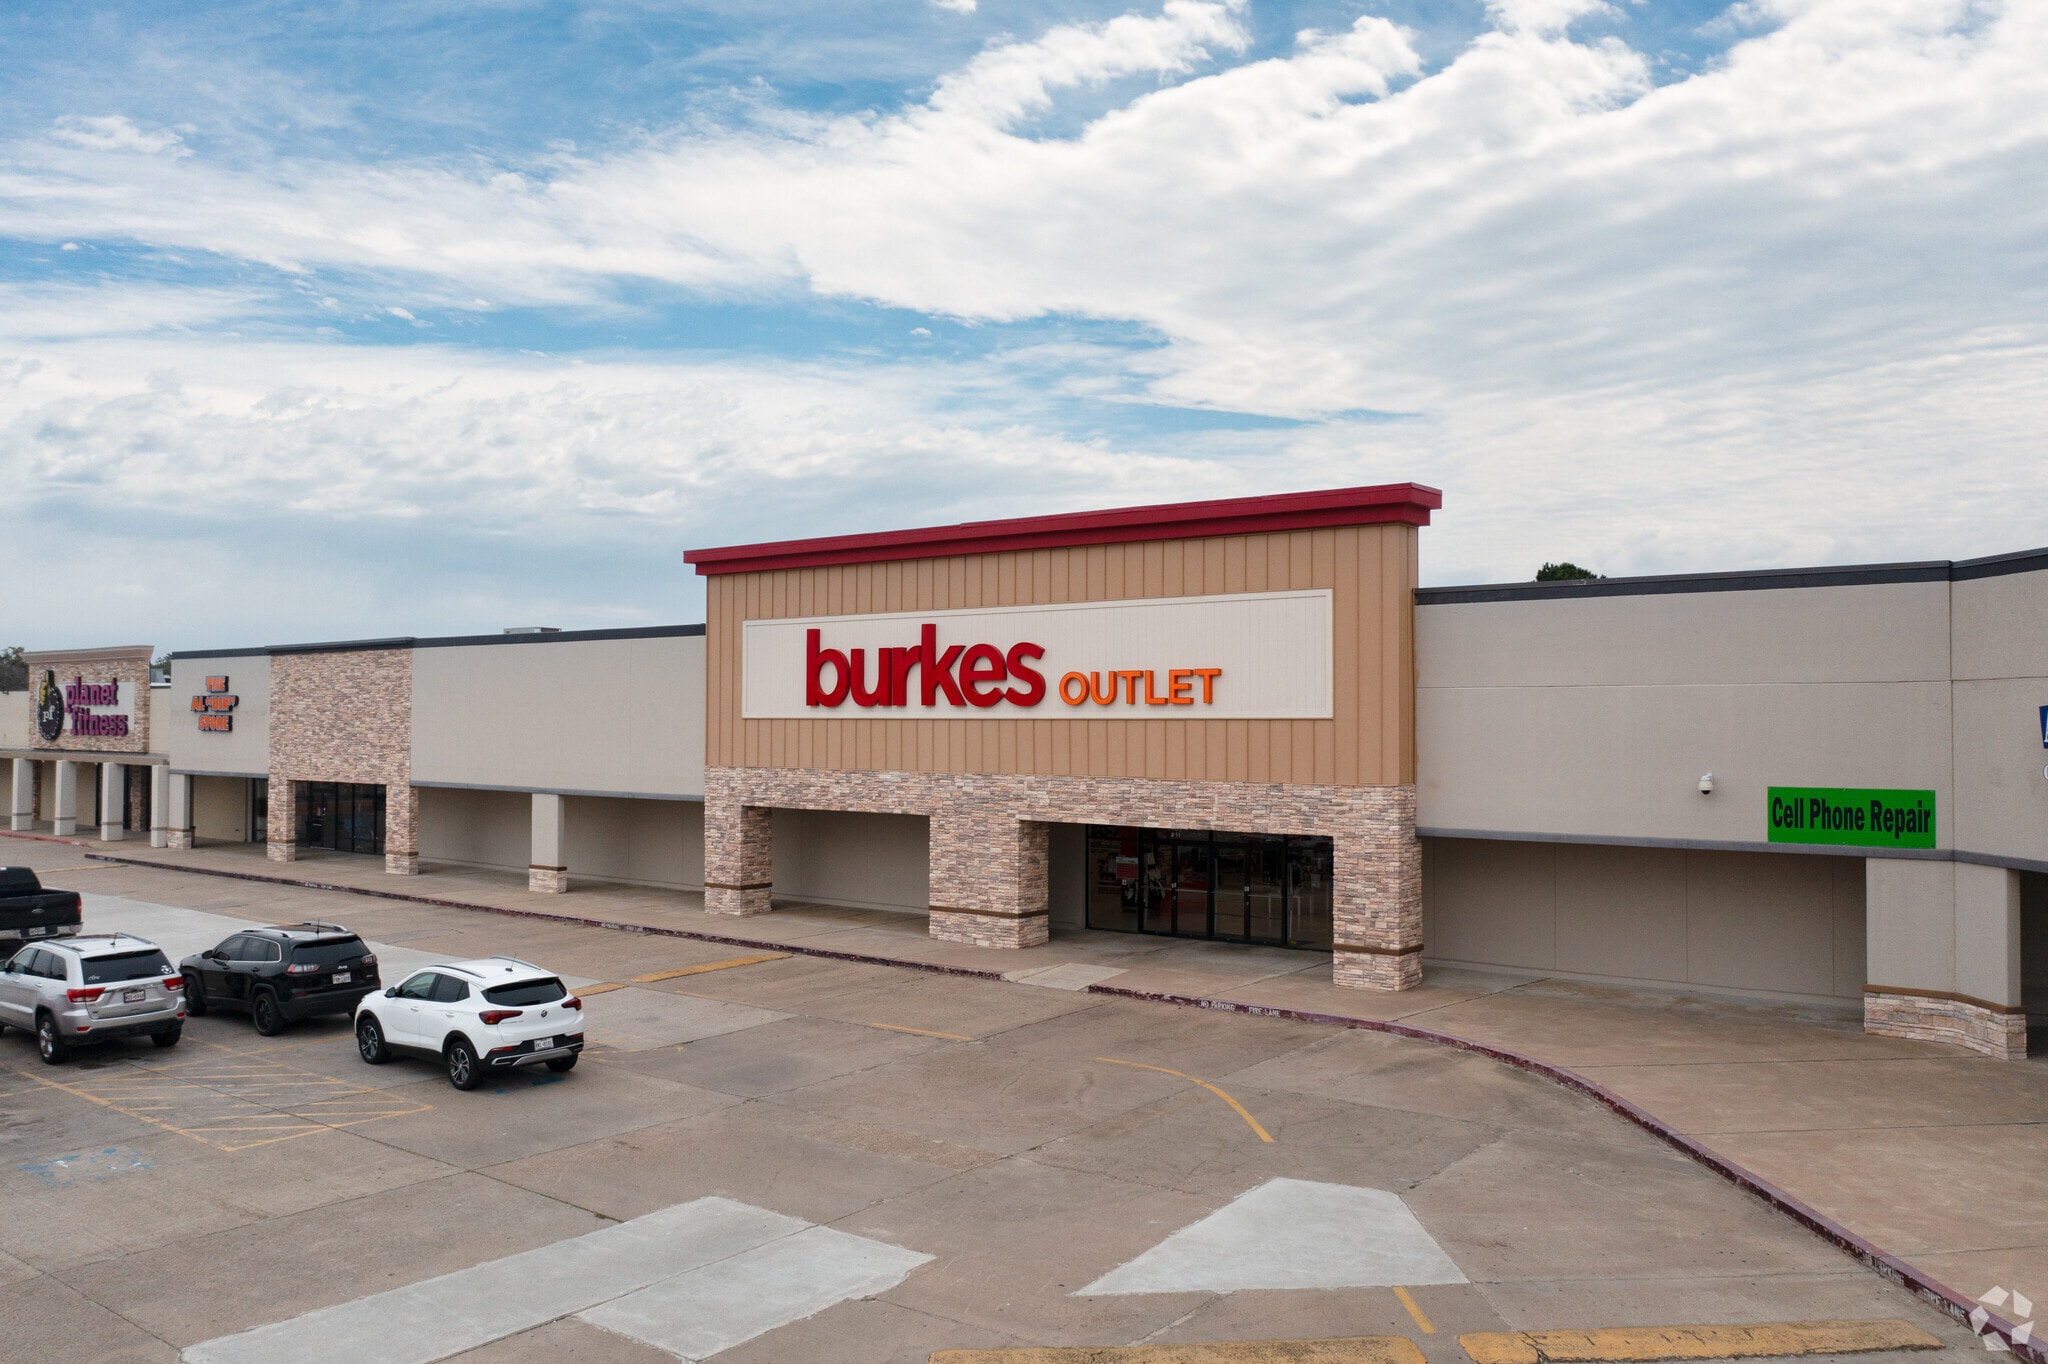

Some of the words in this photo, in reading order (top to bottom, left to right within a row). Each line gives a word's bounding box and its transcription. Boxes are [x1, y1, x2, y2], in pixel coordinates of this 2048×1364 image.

[806, 623, 1046, 707] burkes
[1059, 668, 1222, 706] OUTLET
[65, 676, 118, 712] planet
[206, 676, 229, 692] THE
[43, 705, 55, 722] pf
[71, 707, 128, 736] fitness
[199, 715, 233, 731] STORE
[1772, 797, 1804, 828] Cell
[1809, 798, 1865, 831] Phone
[1870, 800, 1930, 839] Repair
[1211, 1001, 1235, 1011] PARKING
[1248, 1006, 1262, 1014] FIRE
[1265, 1009, 1281, 1017] LANE
